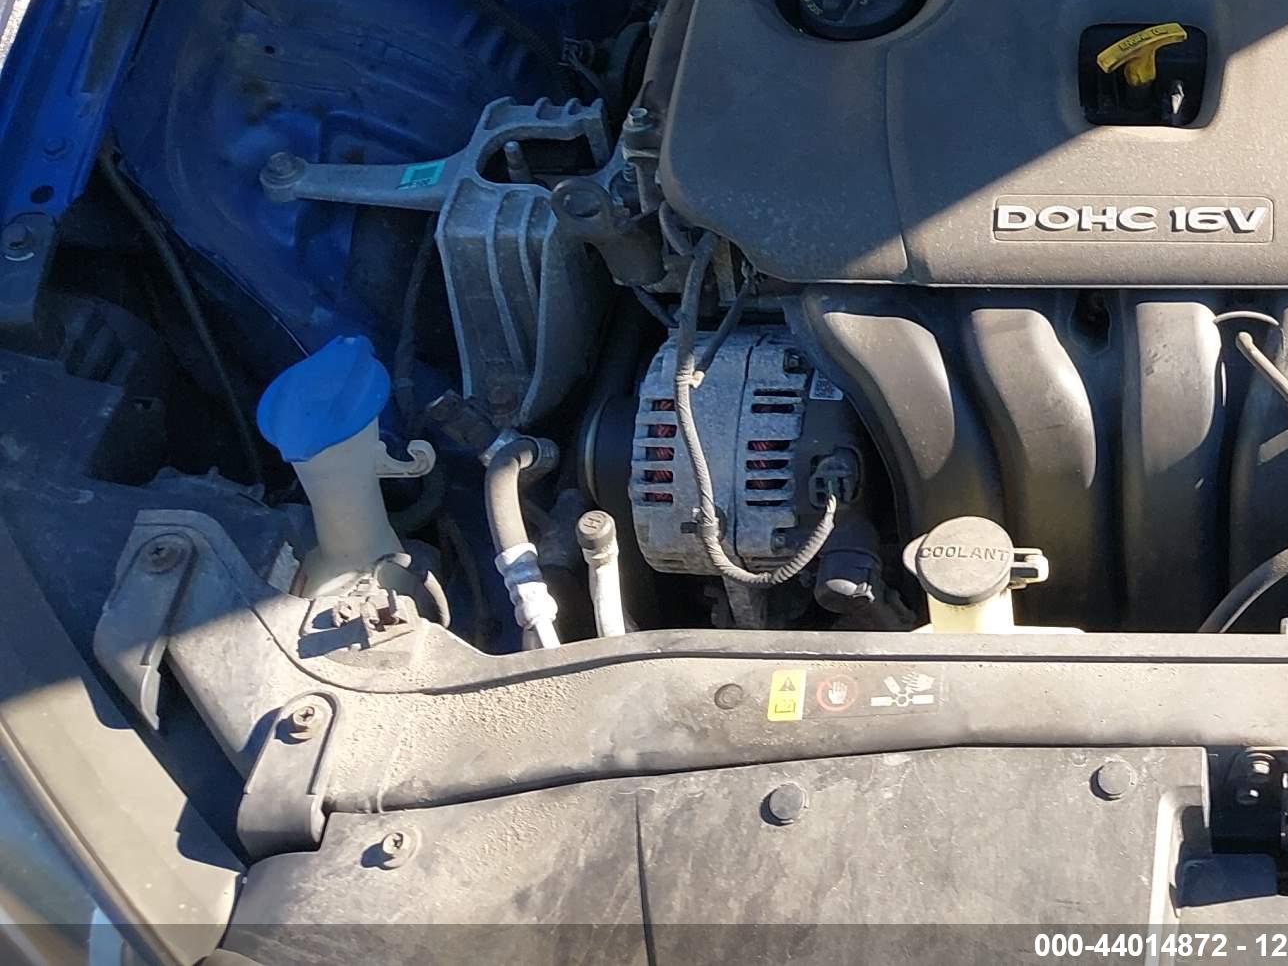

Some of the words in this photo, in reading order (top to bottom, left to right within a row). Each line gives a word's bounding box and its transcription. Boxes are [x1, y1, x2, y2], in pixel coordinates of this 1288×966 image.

[993, 205, 1158, 231] DOHC
[1169, 206, 1268, 233] 16V
[919, 546, 1010, 562] COOLANT
